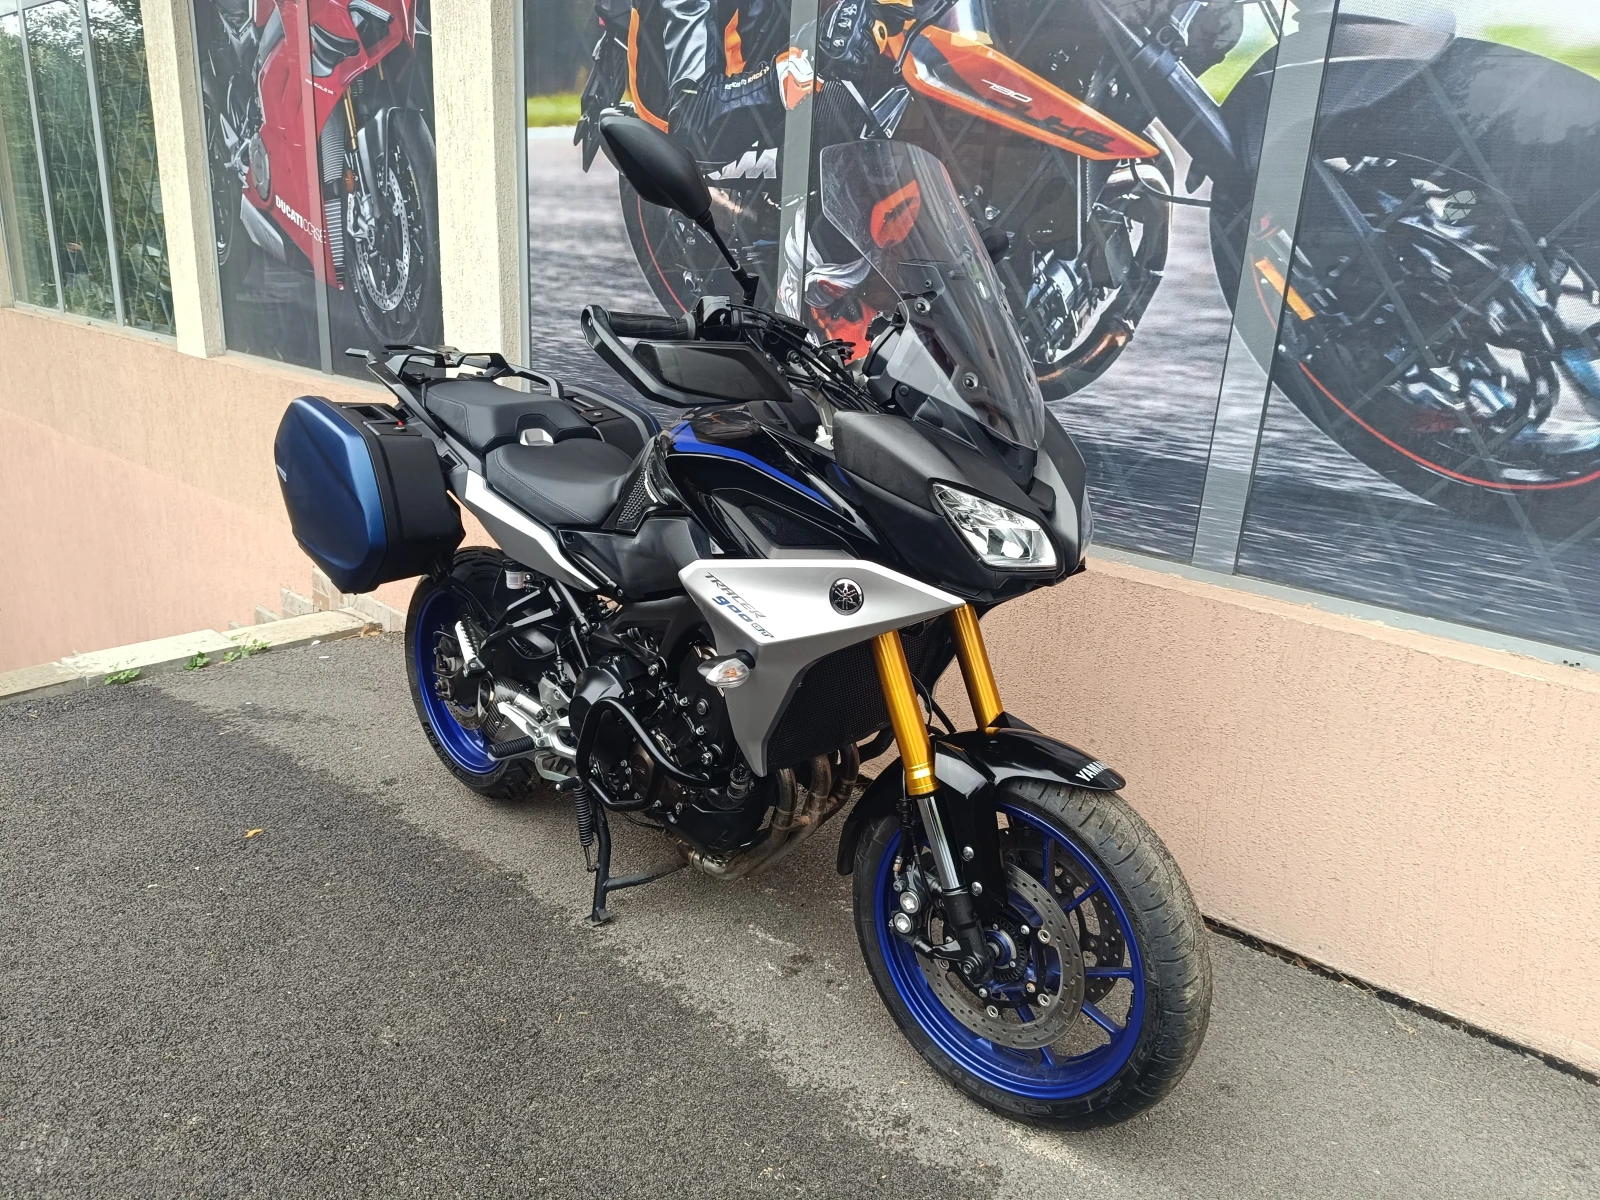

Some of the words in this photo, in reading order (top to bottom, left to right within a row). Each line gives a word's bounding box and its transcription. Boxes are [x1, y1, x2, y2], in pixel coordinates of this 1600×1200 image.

[275, 194, 304, 229] DUCATI
[704, 571, 767, 619] TRACER
[711, 595, 754, 623] 900
